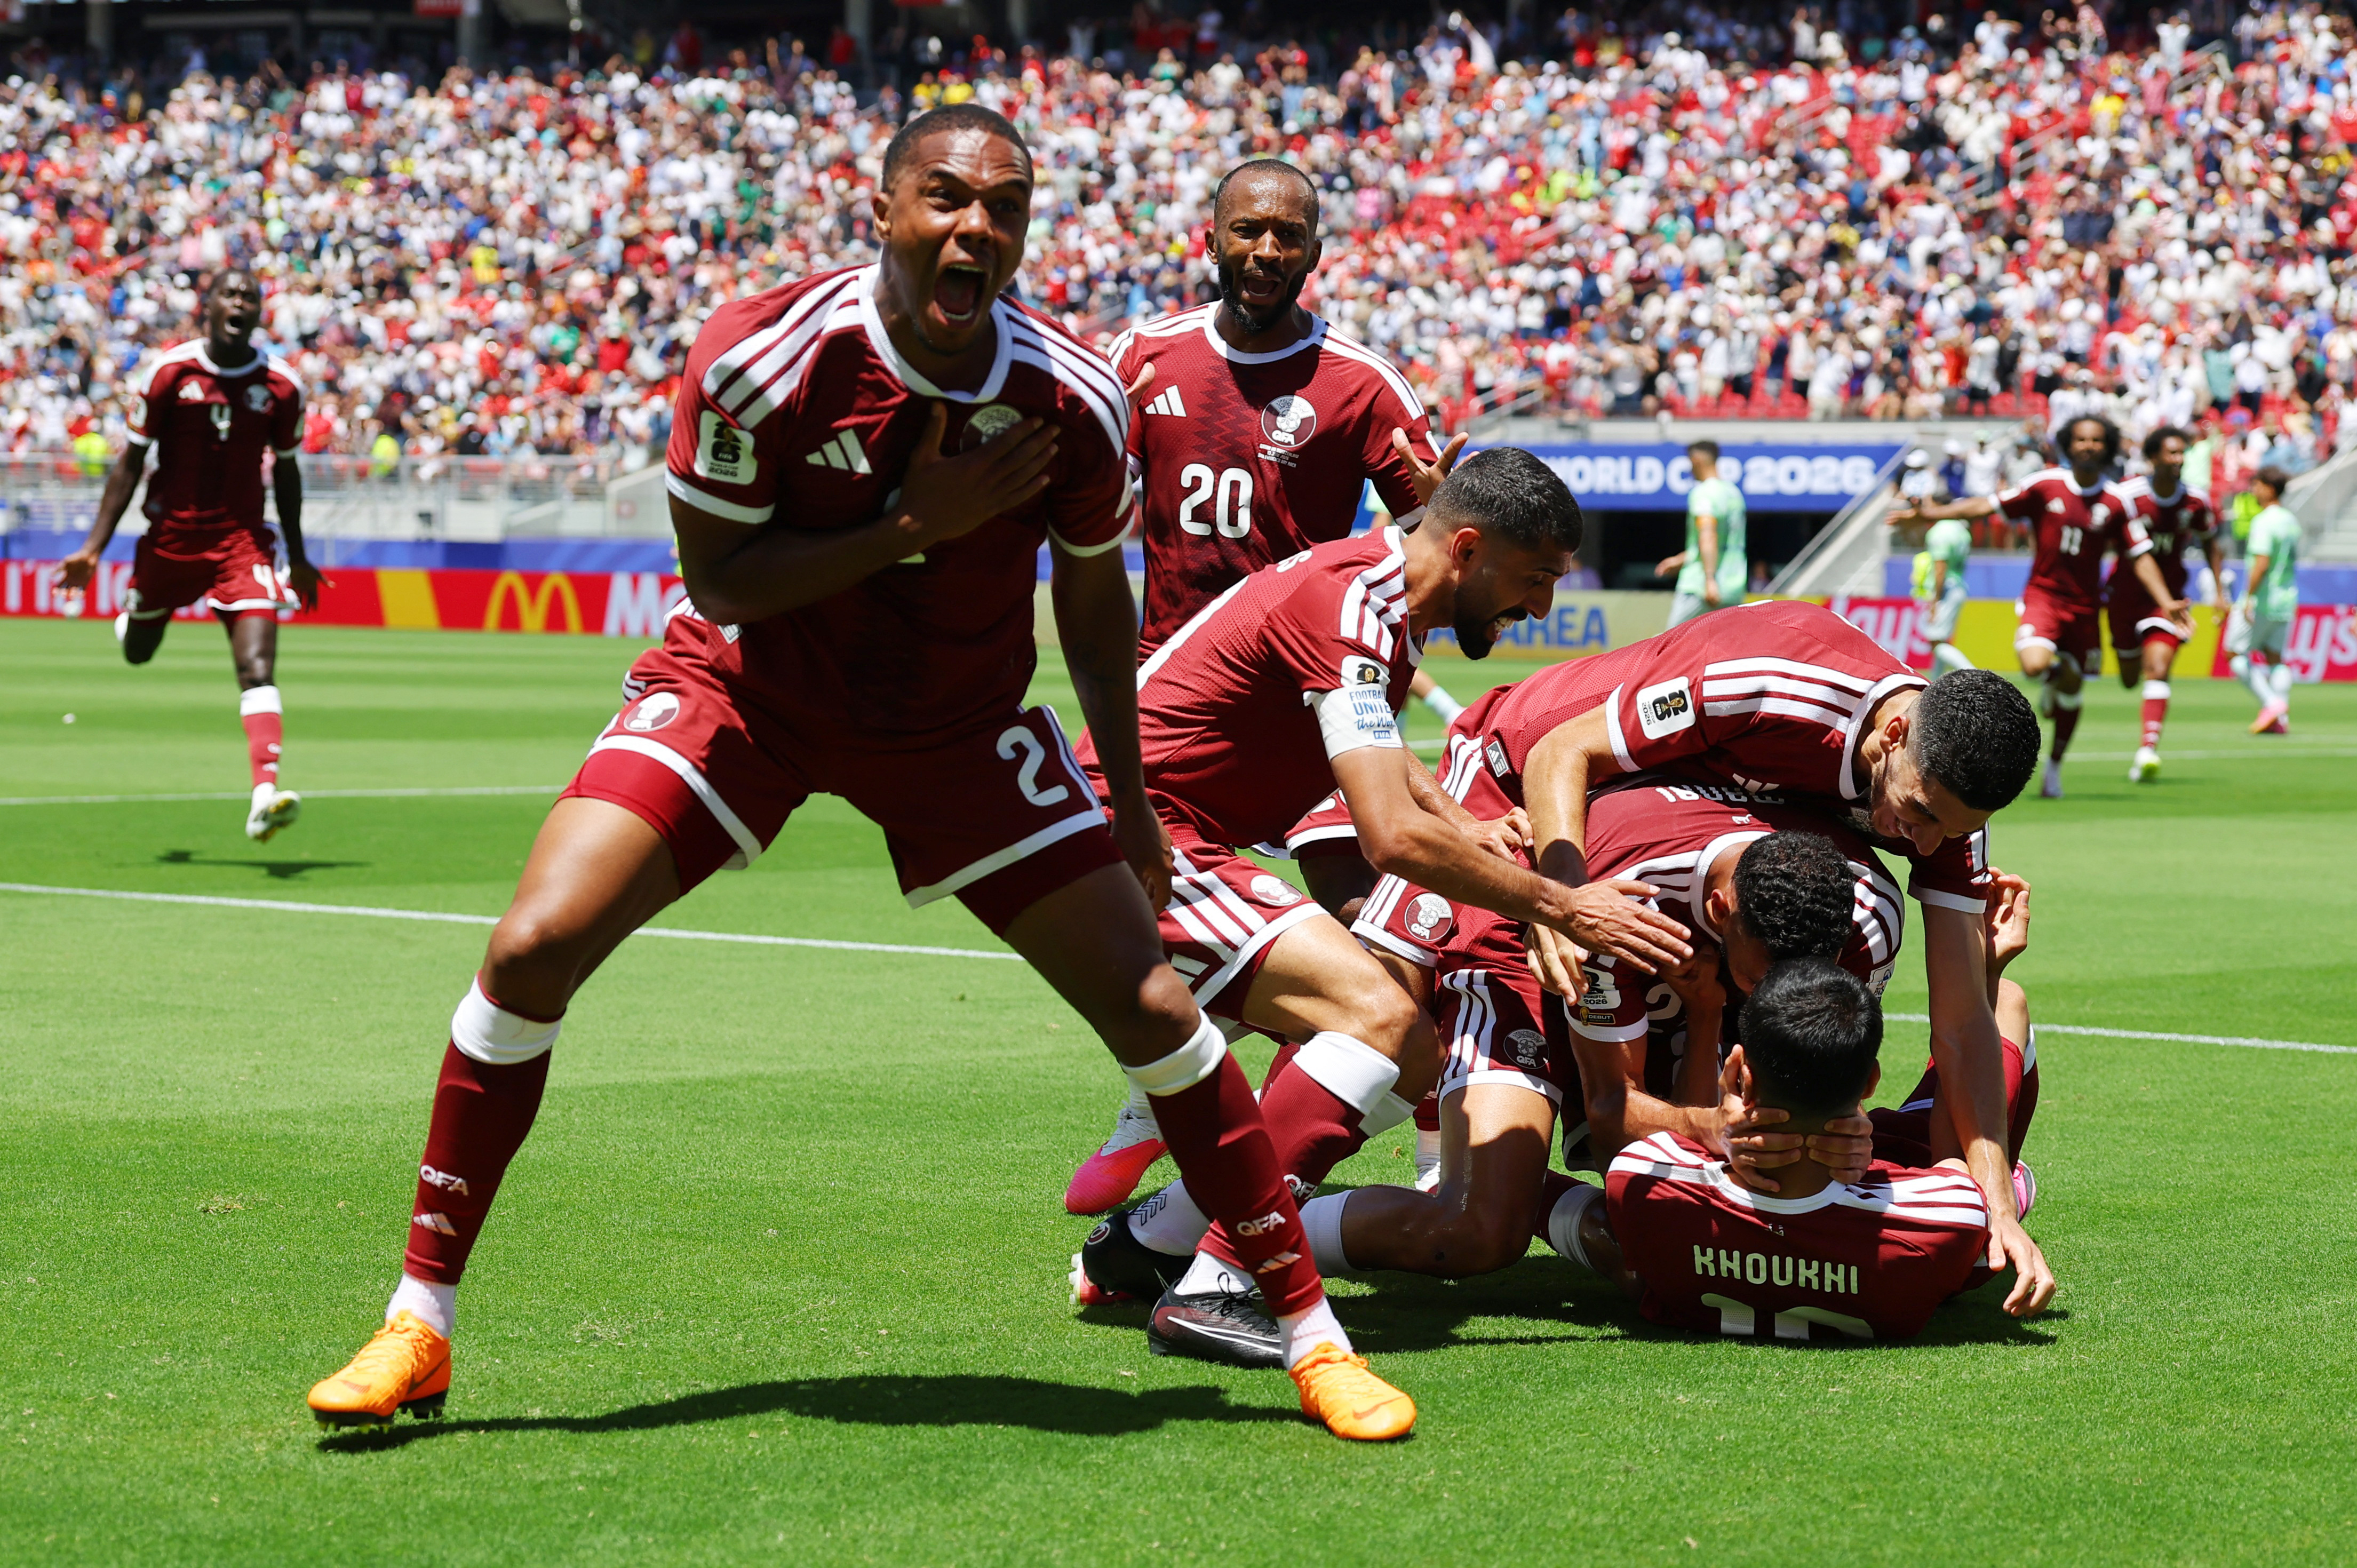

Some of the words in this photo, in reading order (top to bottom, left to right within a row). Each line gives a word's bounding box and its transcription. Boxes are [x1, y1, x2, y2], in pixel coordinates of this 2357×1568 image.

[210, 404, 232, 442] 4
[1272, 430, 1295, 445] QFA
[1538, 455, 1666, 495] WORLD
[1666, 455, 1743, 496] CP
[1743, 456, 1877, 496] 2026
[1180, 463, 1253, 538] 20
[252, 563, 278, 600] 4
[1354, 717, 1375, 730] the
[1642, 702, 1652, 726] 2026
[996, 725, 1070, 807] 2
[1411, 922, 1430, 940] QFA
[1516, 1055, 1536, 1067] QFA
[420, 1165, 468, 1196] QFA
[1237, 1211, 1287, 1236] QFA
[1693, 1245, 1858, 1294] KHOUKHI
